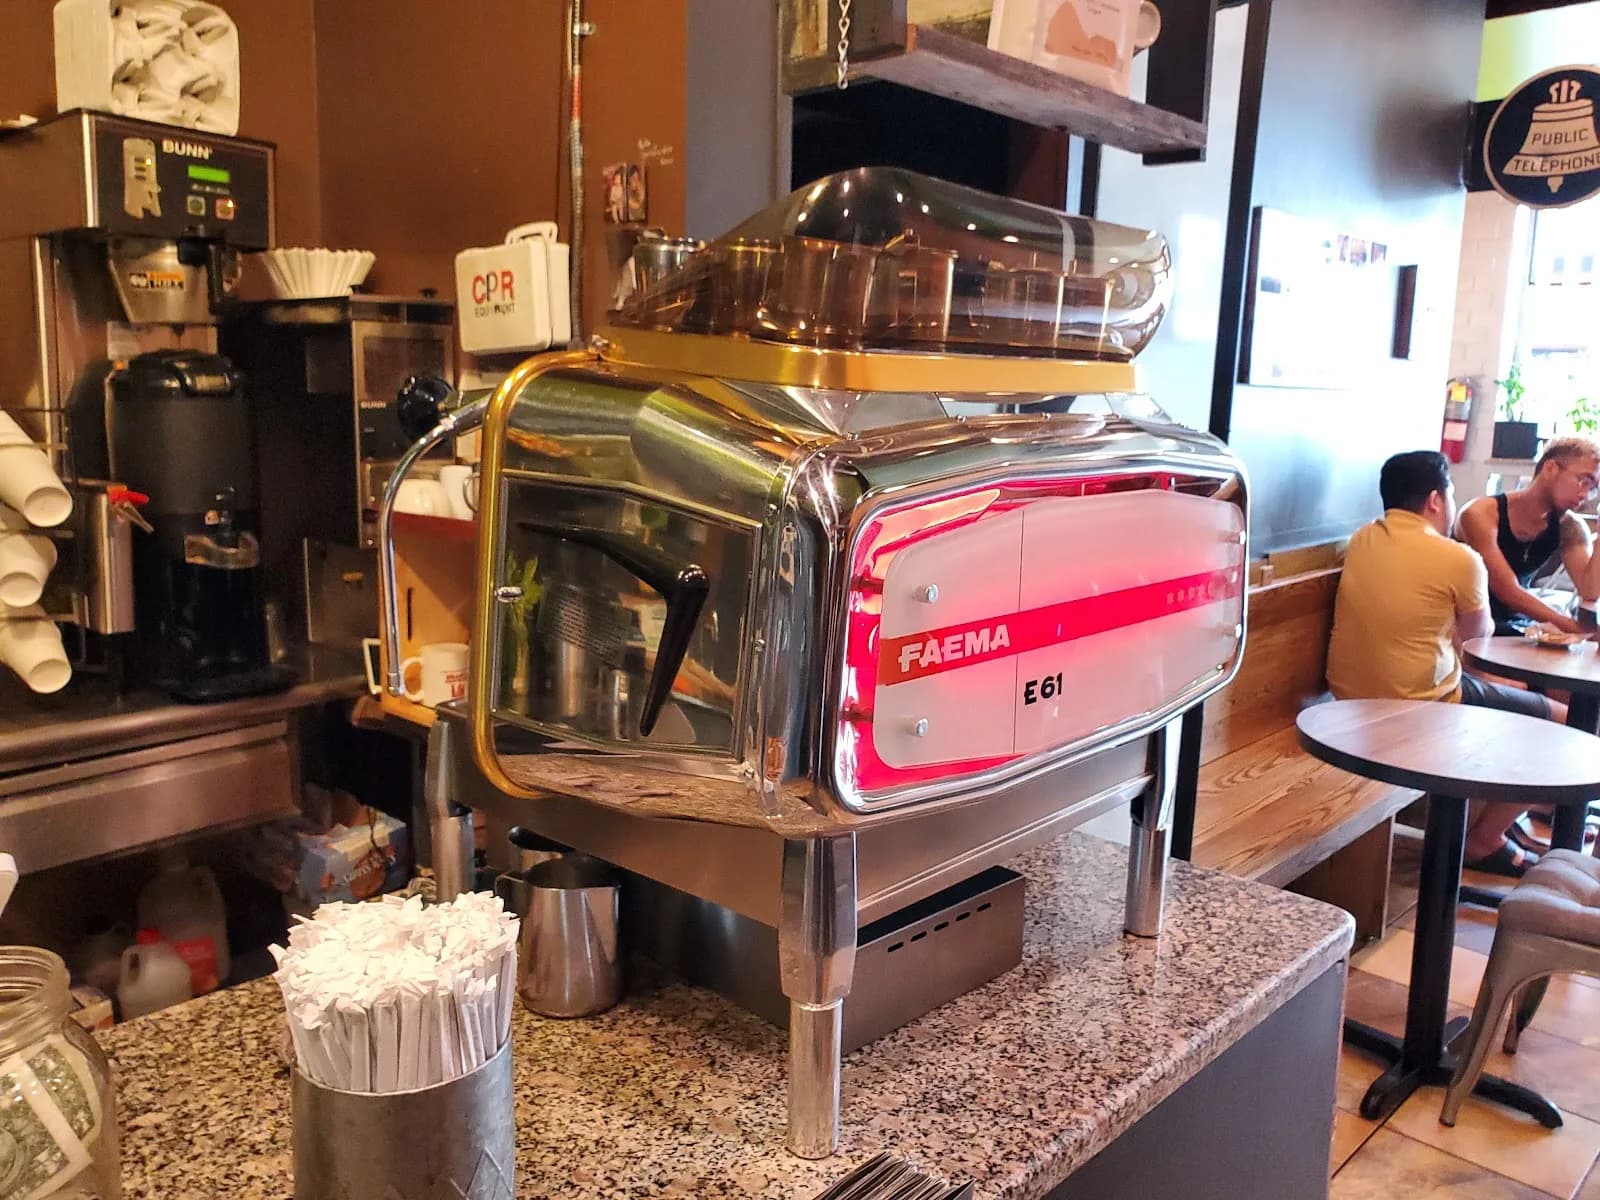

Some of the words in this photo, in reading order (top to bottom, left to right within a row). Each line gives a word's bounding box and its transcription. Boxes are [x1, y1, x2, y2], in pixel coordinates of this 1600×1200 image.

[1531, 128, 1590, 146] PUBLIC
[472, 270, 515, 305] CPR
[474, 303, 515, 318] EQUMENT
[898, 623, 1011, 673] FAEMA
